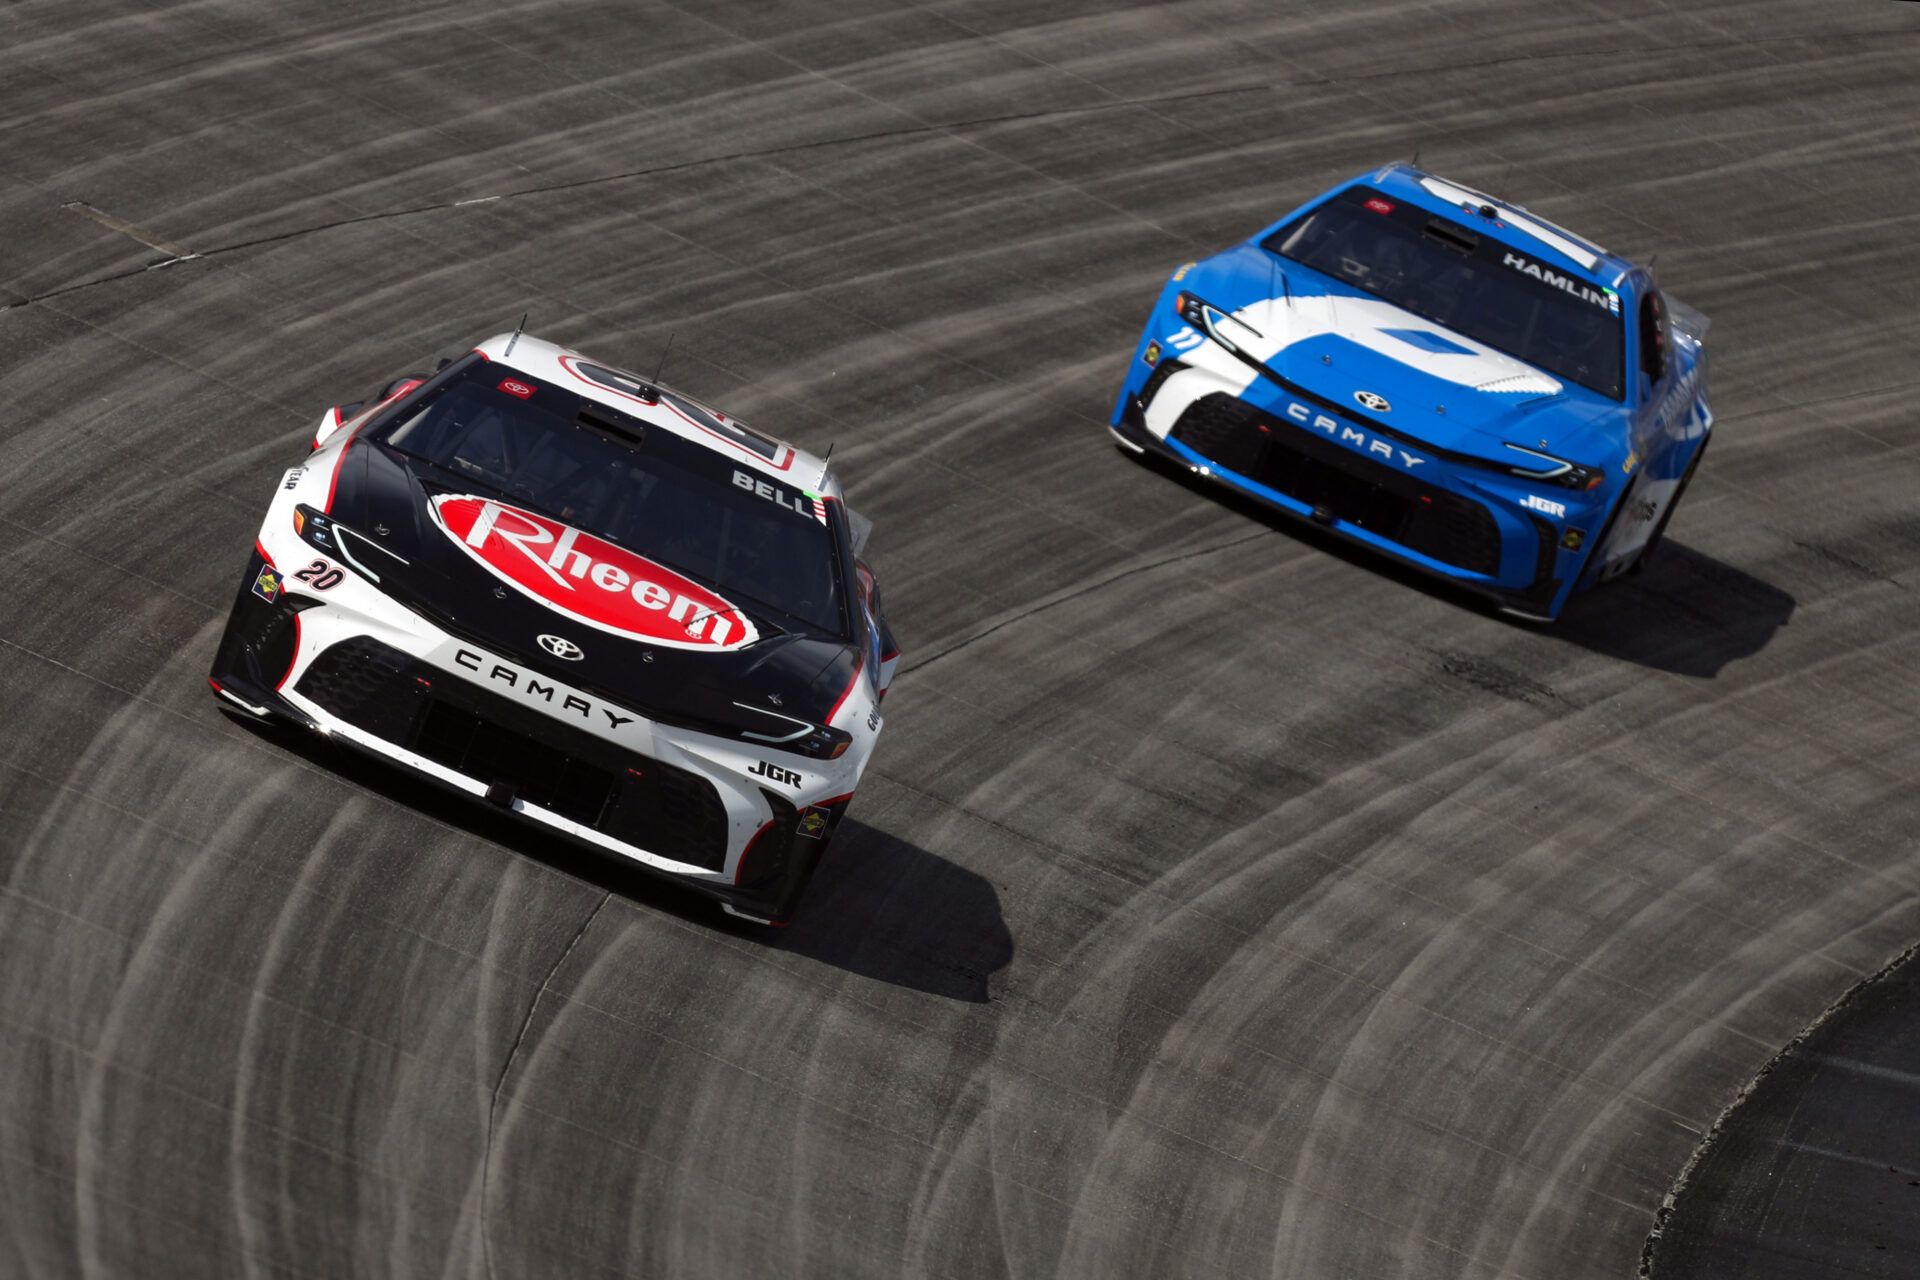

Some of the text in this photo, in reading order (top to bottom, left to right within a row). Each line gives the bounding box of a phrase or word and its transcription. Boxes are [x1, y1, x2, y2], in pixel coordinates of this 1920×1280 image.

[1503, 253, 1609, 310] HAMLIN
[1286, 402, 1425, 468] CAMRY
[732, 470, 813, 519] BELL
[1520, 494, 1566, 519] JGR
[292, 558, 346, 592] 20
[466, 501, 733, 647] Rheem
[455, 649, 634, 728] CAMRY
[748, 760, 802, 790] JGR
